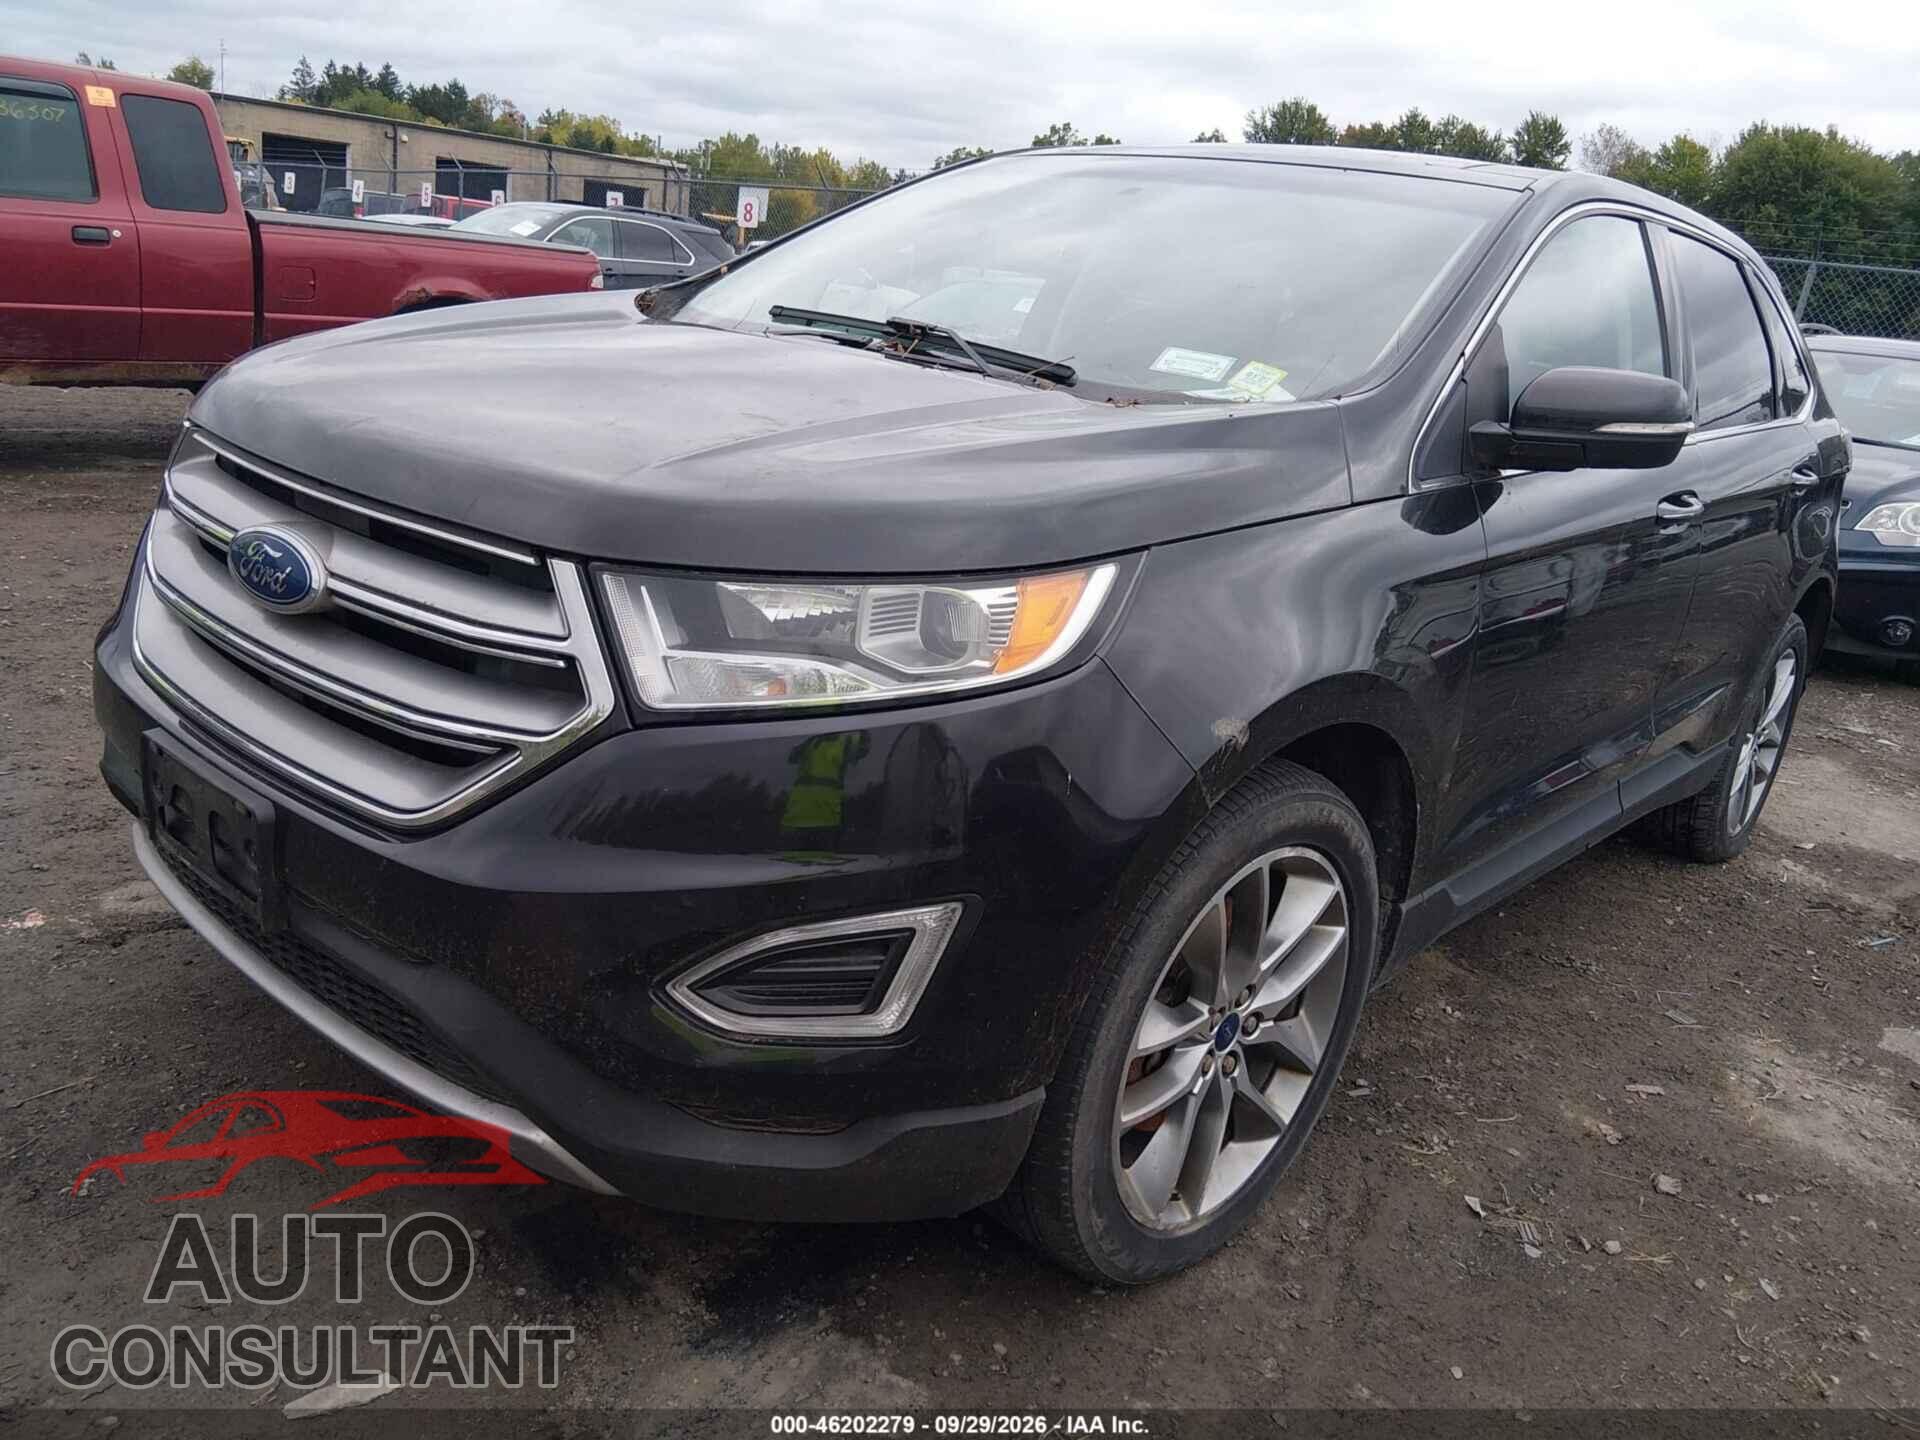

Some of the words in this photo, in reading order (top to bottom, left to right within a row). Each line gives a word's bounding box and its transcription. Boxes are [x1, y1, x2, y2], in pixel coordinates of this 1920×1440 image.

[354, 184, 362, 200] 4
[743, 202, 753, 223] 8
[239, 540, 293, 594] Ford
